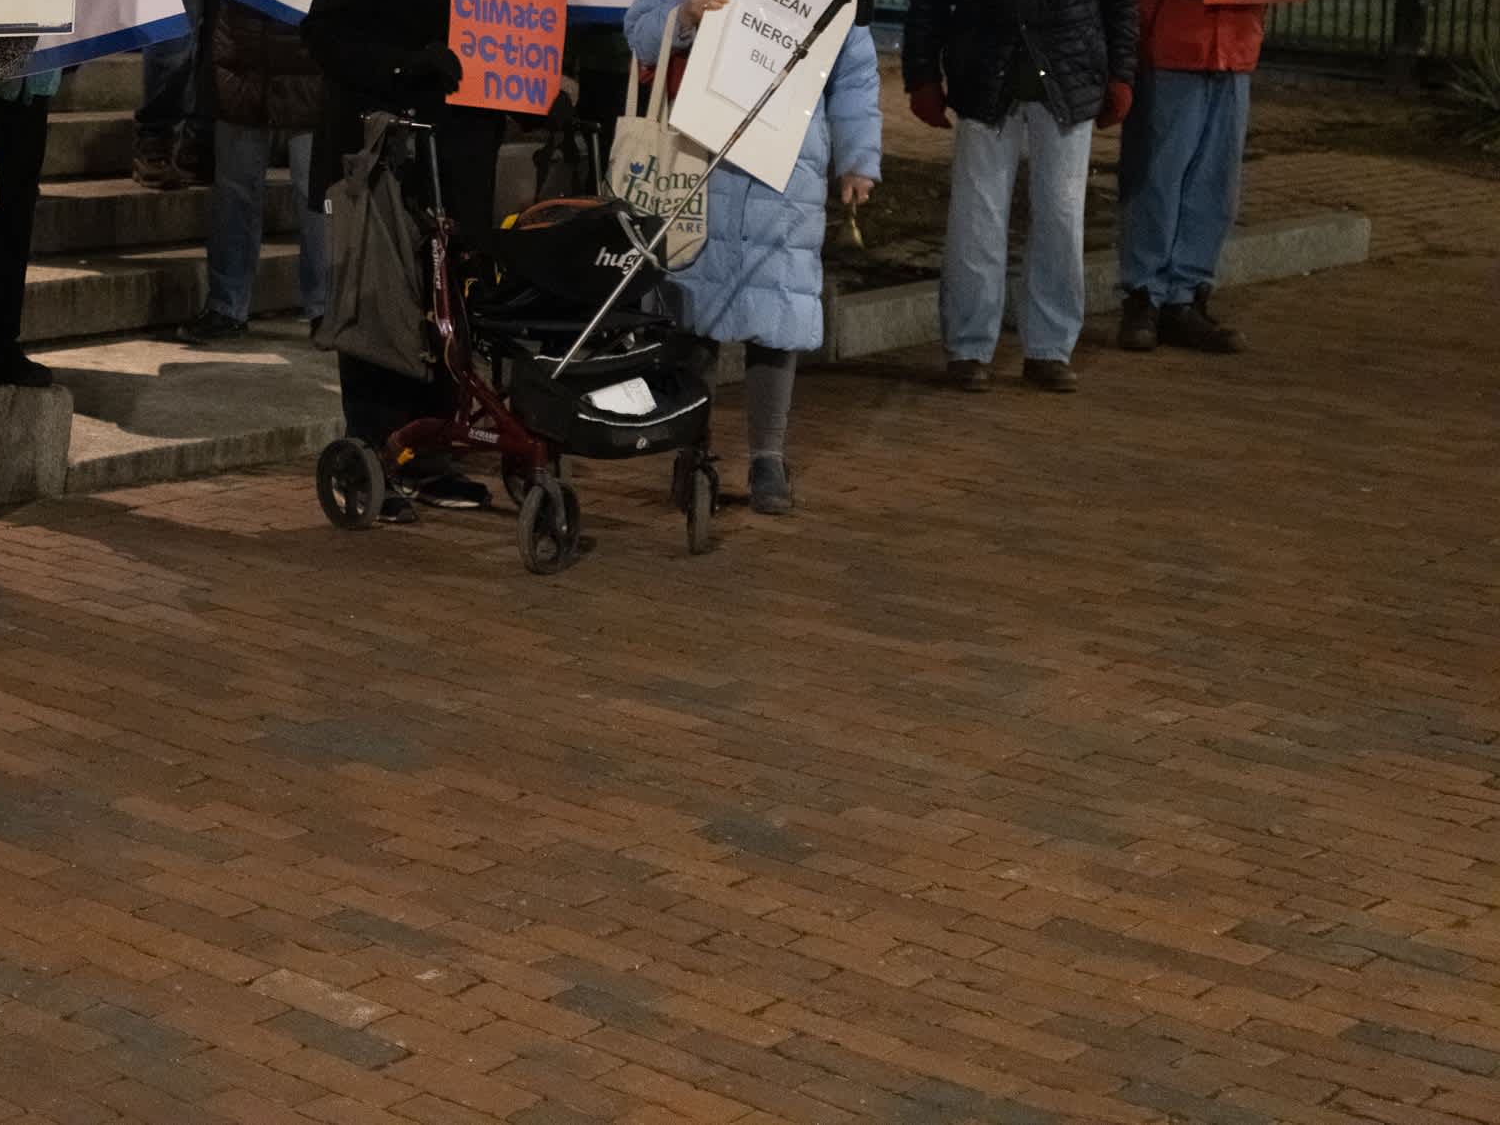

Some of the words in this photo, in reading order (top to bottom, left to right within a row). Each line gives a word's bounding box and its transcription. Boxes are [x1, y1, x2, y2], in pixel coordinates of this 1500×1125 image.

[461, 30, 559, 75] action
[750, 49, 778, 74] BILL
[484, 71, 547, 107] now
[669, 222, 703, 234] ARE
